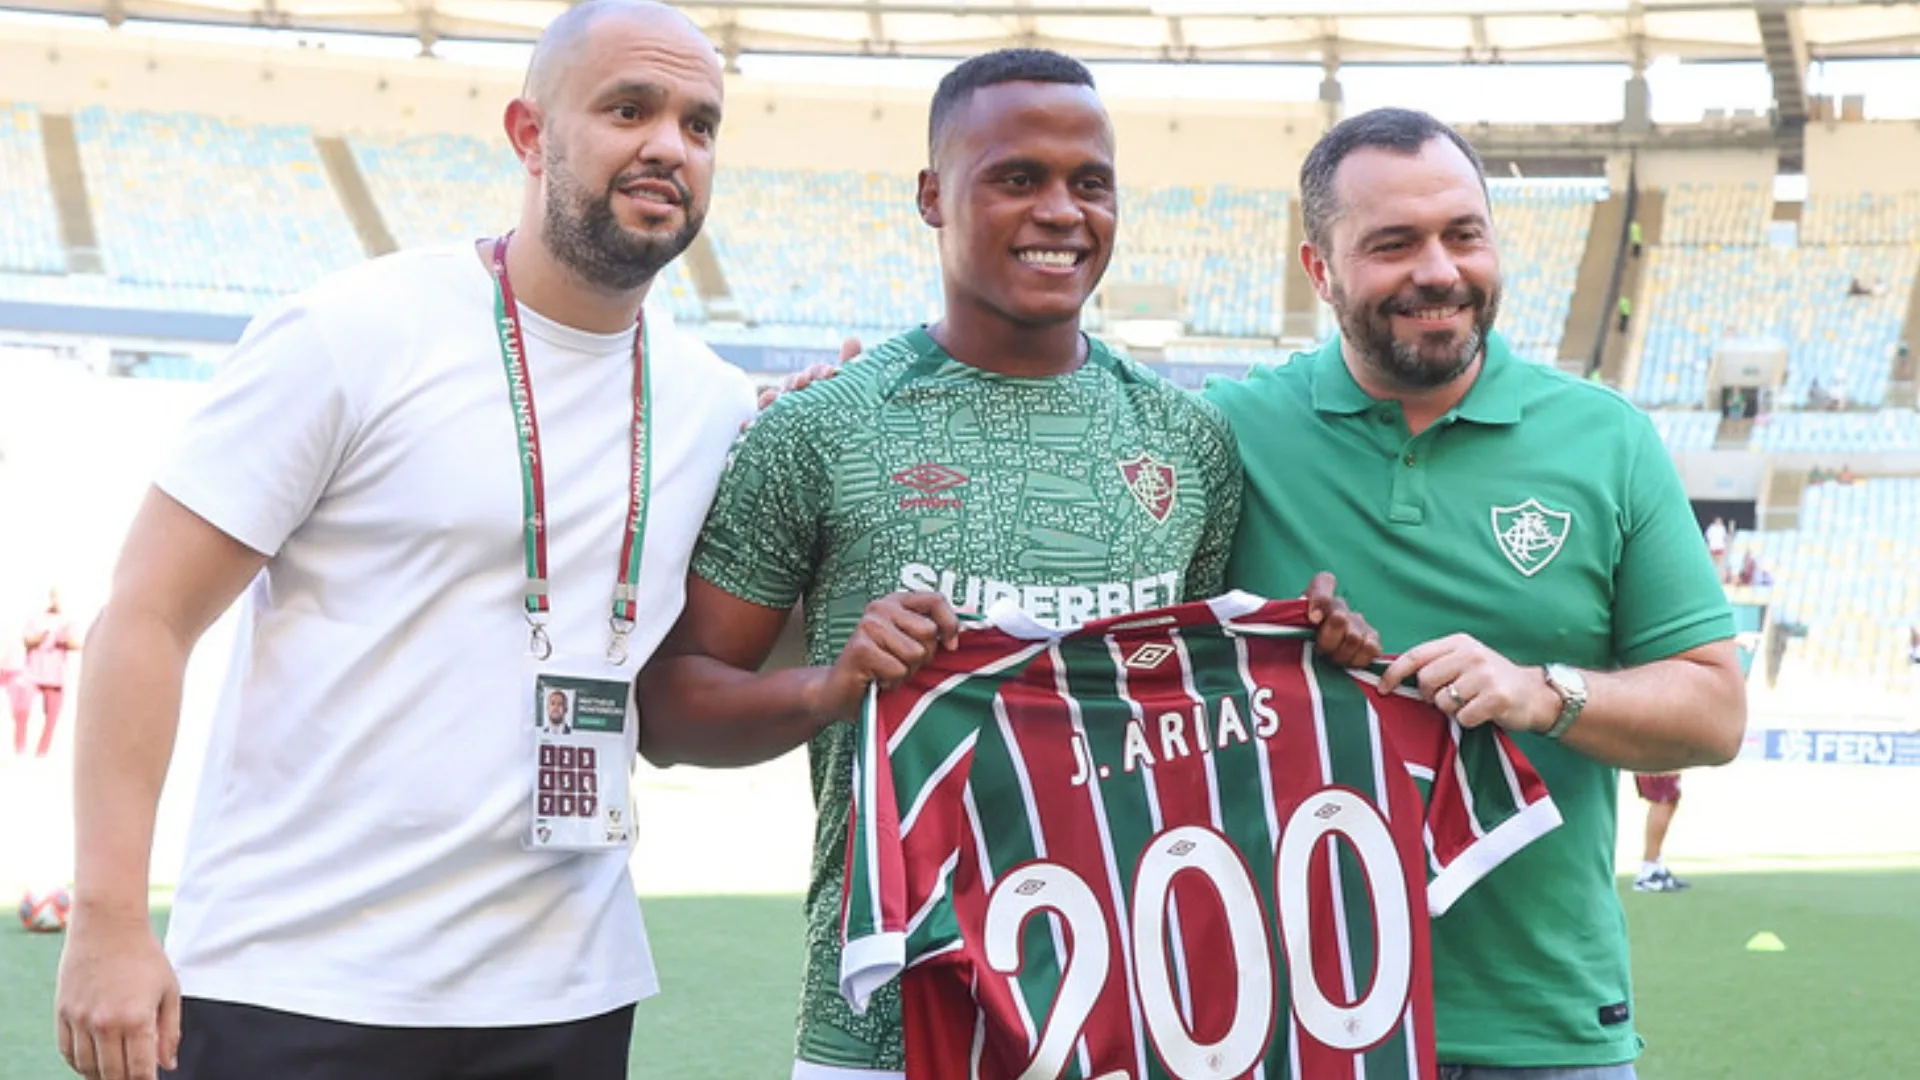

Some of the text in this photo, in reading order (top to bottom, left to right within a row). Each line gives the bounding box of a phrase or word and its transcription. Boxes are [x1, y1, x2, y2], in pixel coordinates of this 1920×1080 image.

[500, 317, 533, 436] FLUMINENSE
[900, 563, 1178, 630] SUPERBET
[1070, 688, 1279, 786] J. ARIAS
[1816, 733, 1894, 763] FERJ
[984, 788, 1413, 1080] 200
